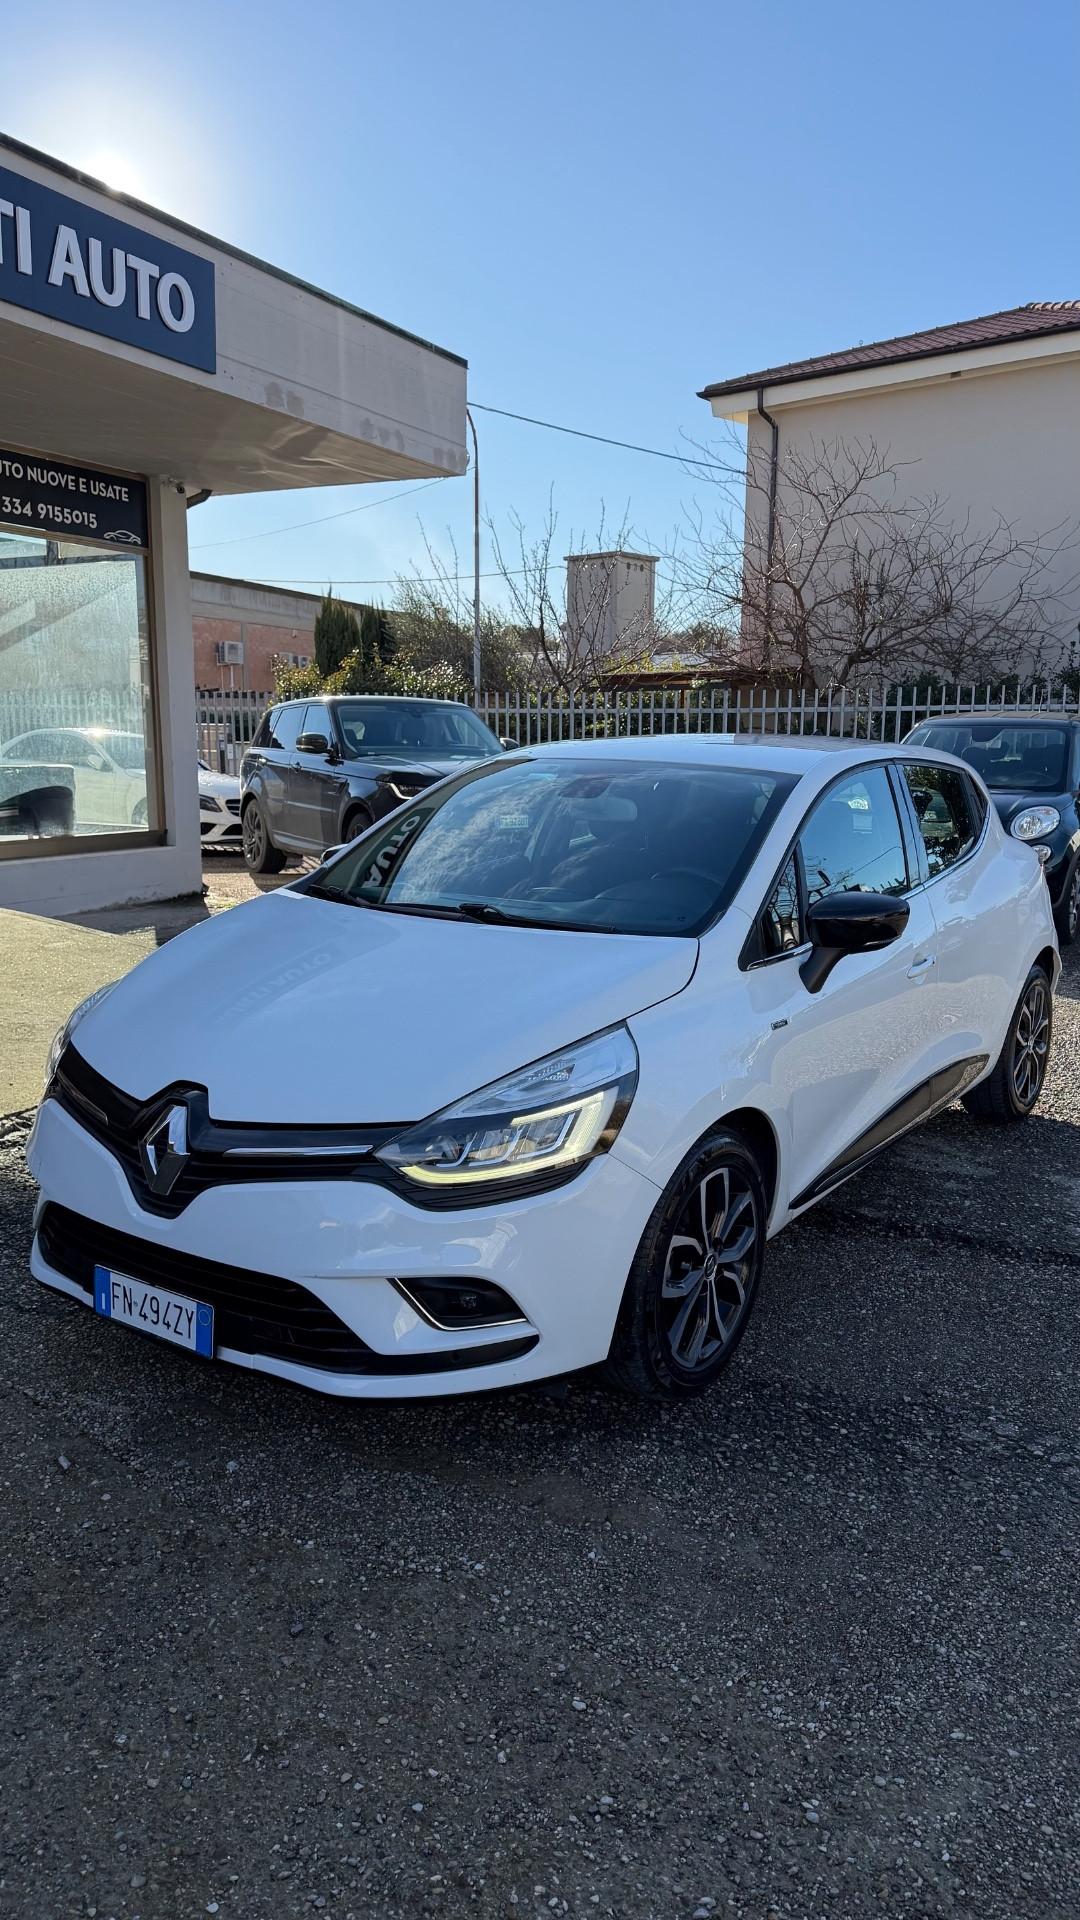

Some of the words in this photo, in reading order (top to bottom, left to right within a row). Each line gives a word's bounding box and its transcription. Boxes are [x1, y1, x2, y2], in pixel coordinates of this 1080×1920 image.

[48, 224, 195, 333] AUTO
[0, 460, 24, 479] TO
[27, 466, 76, 491] NUOVE
[79, 477, 88, 493] E
[90, 480, 129, 502] USATE
[1, 496, 33, 517] 334
[37, 503, 98, 529] 9155015
